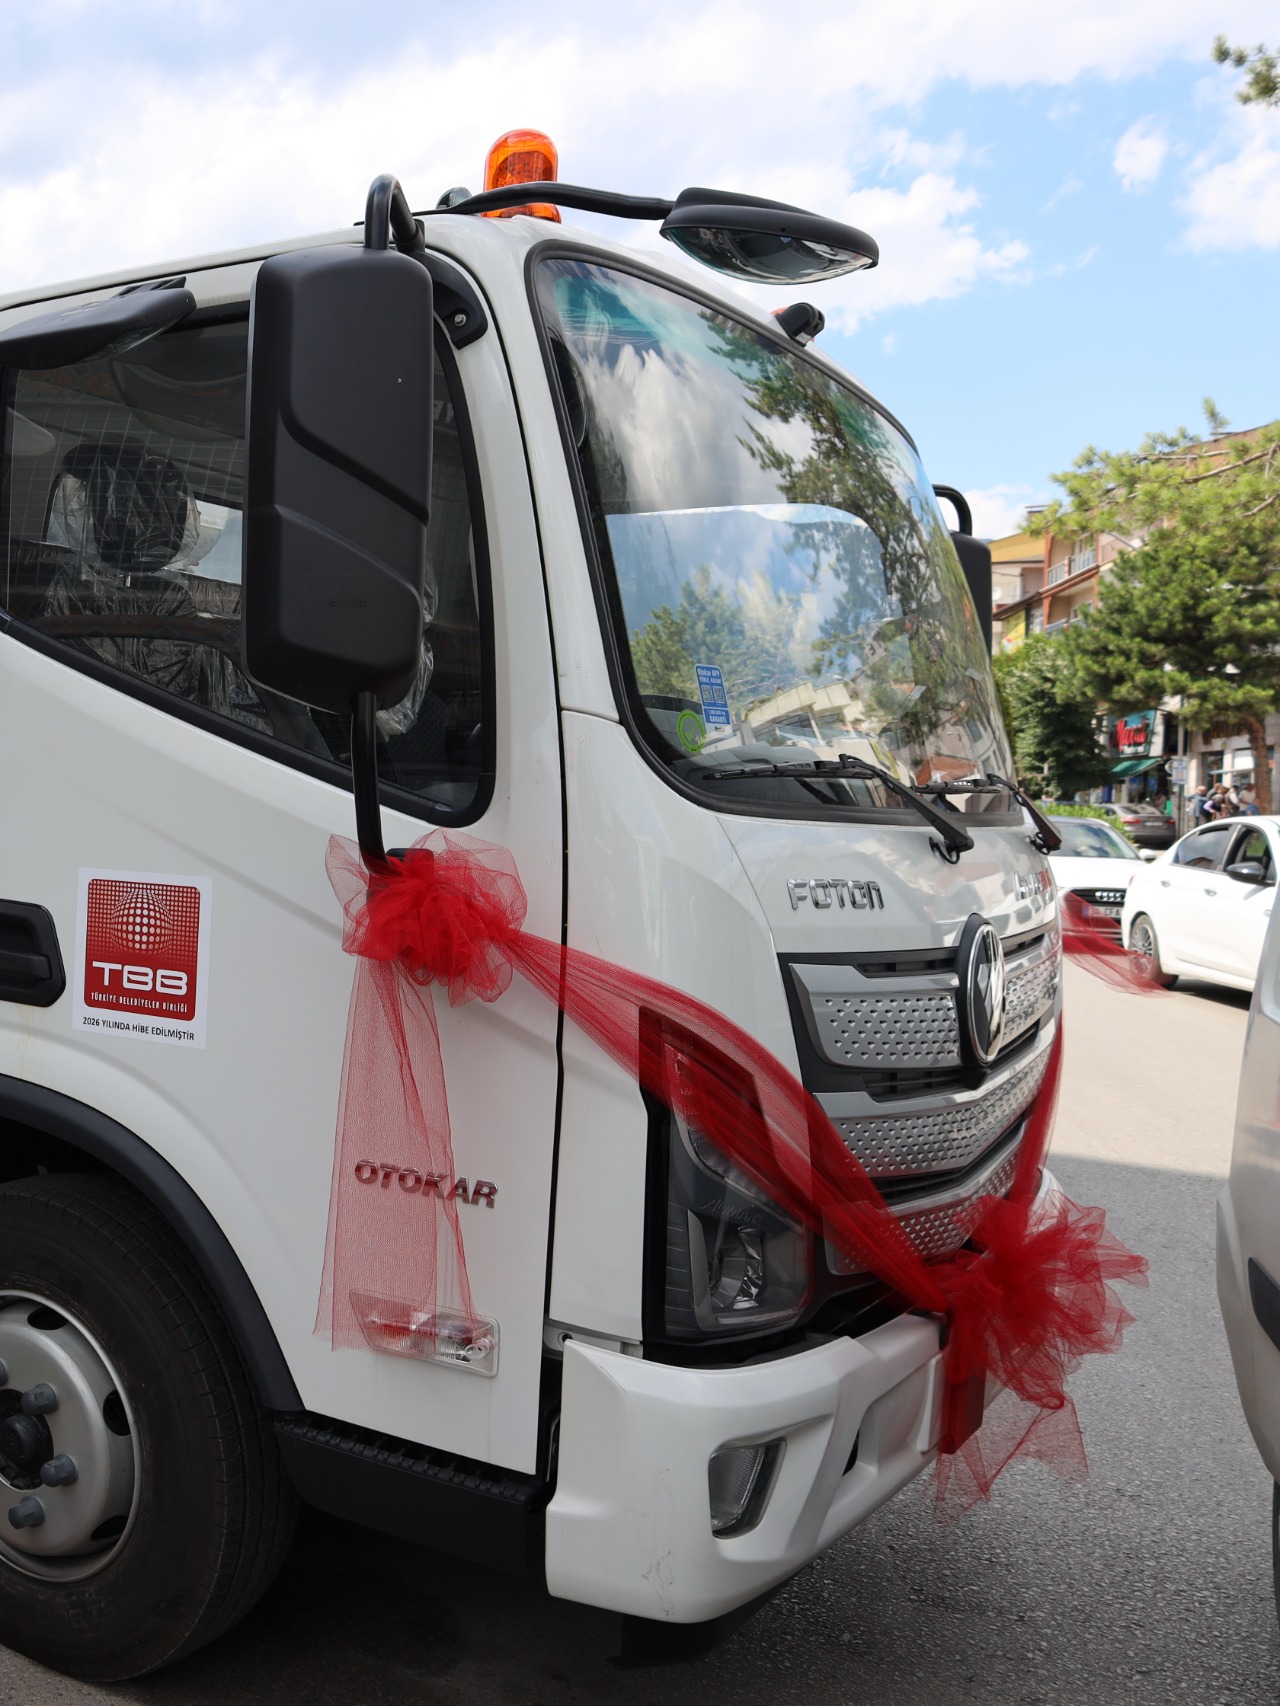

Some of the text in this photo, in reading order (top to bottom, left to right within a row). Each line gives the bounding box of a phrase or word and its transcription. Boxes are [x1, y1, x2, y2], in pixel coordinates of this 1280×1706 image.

[787, 879, 884, 910] FOTON
[92, 960, 188, 996] TBB
[91, 992, 188, 1013] TÜRKİYE BELEDİYELER BİRLİĞİ
[82, 1016, 195, 1041] 2026 YILINDA HİBE EDİLMİŞTİR
[354, 1159, 499, 1209] OTOKAR
